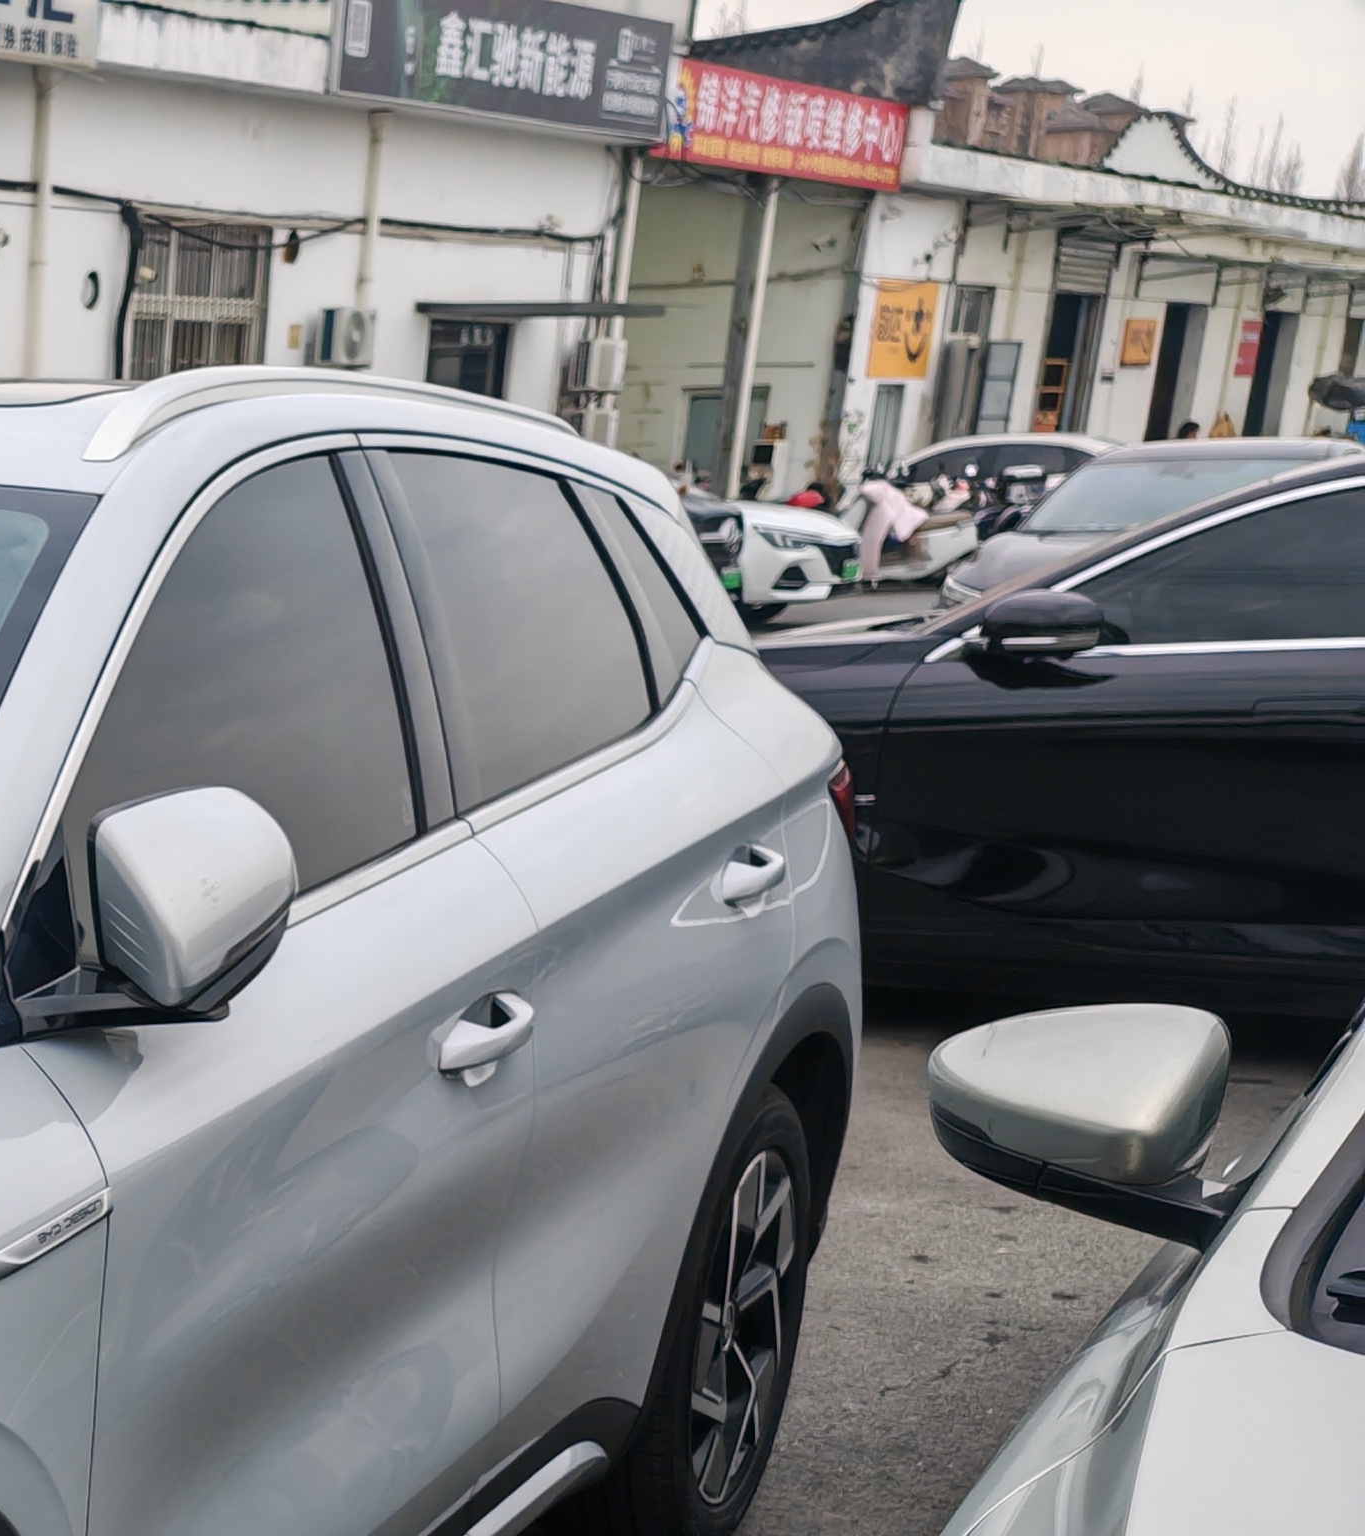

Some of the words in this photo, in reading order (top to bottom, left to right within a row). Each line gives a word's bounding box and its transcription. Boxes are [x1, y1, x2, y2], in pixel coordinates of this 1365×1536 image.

[435, 10, 598, 100] 鑫汇驰新能源
[37, 1223, 61, 1244] BYD
[63, 1199, 102, 1229] DESIGN
